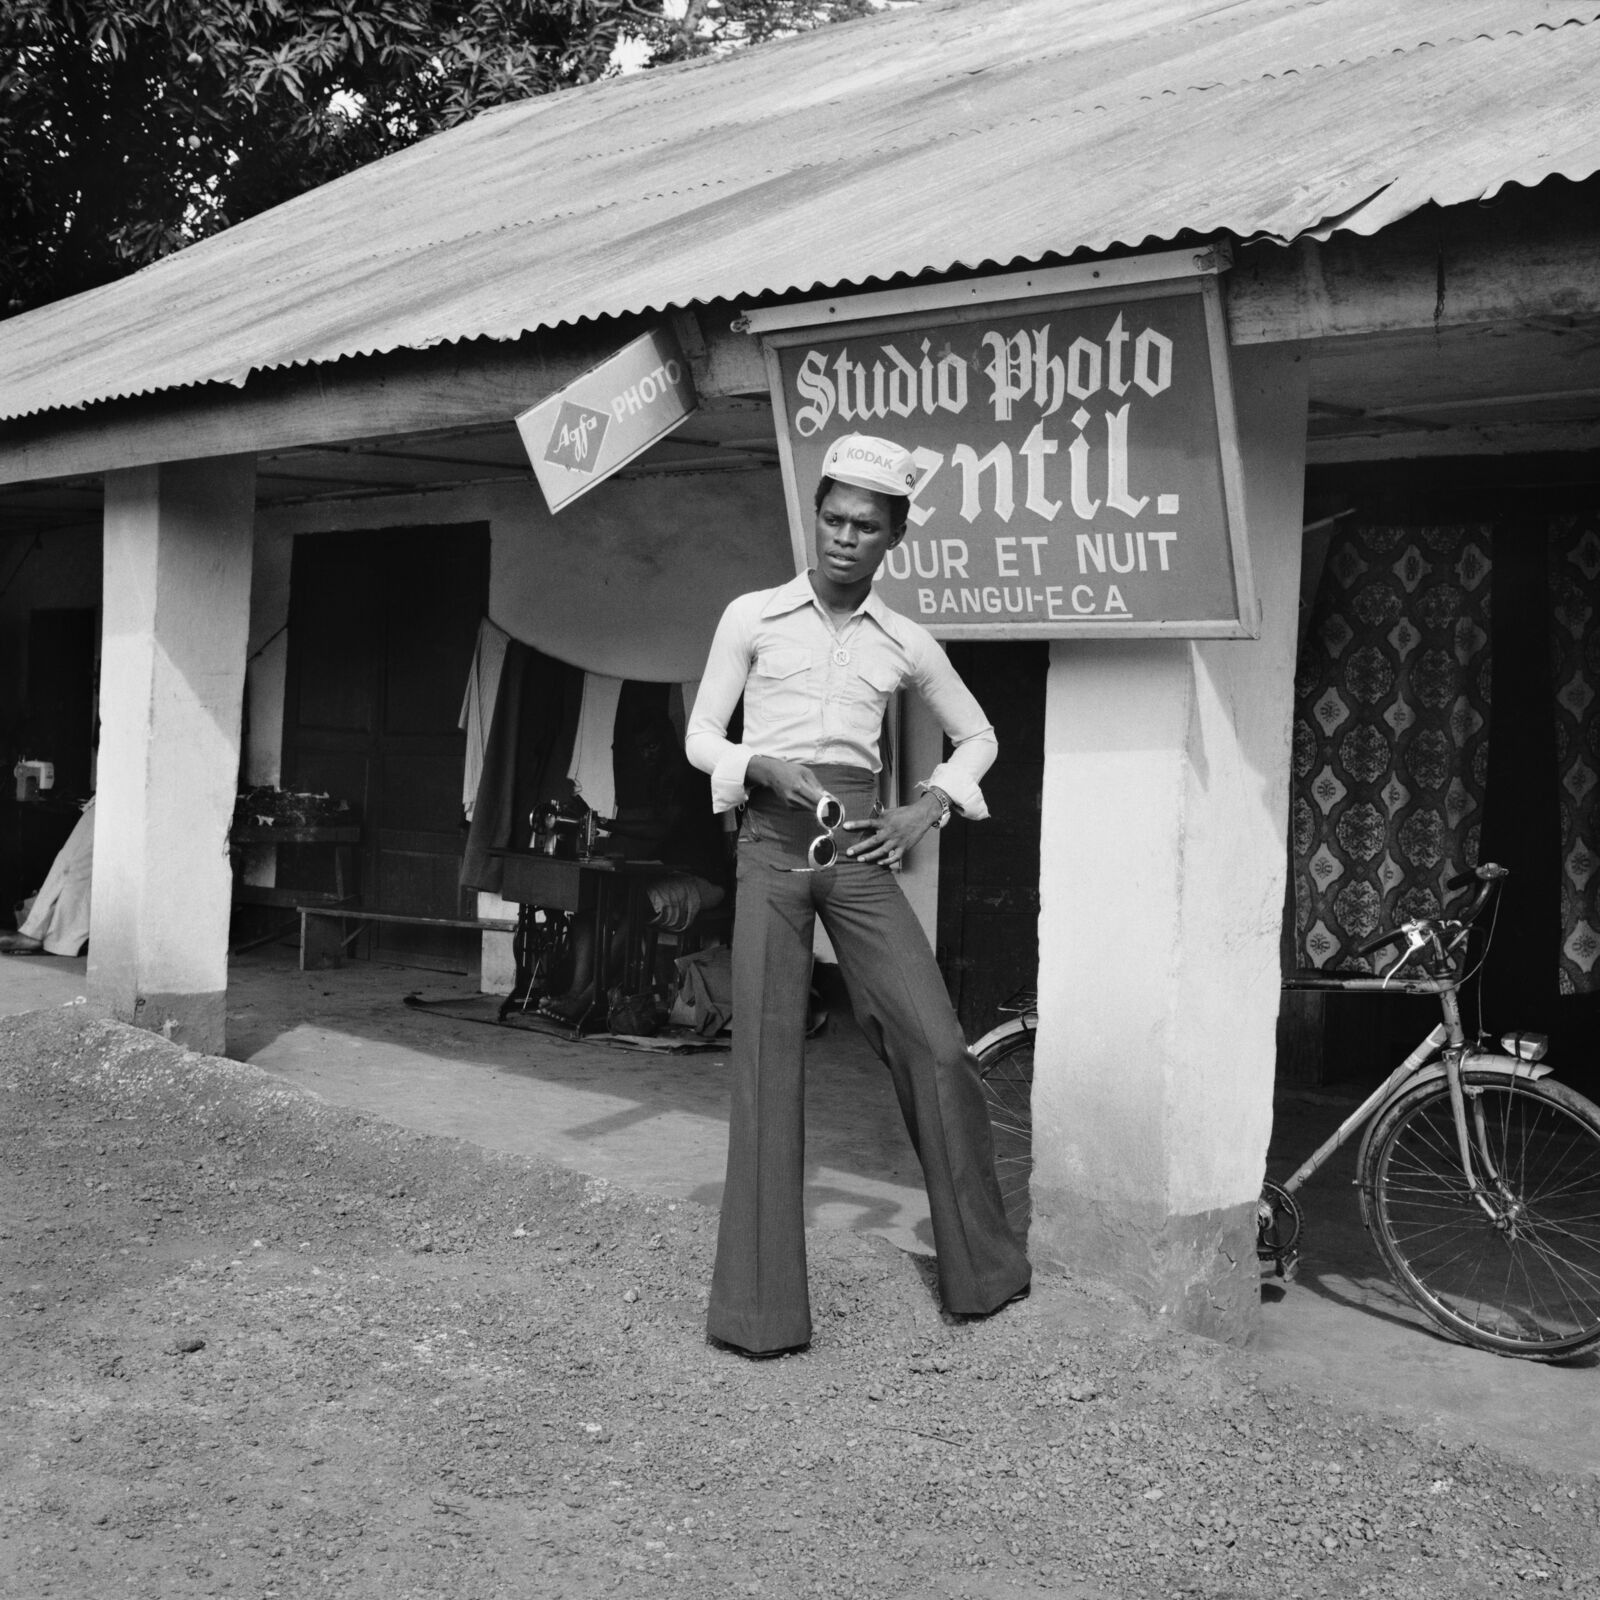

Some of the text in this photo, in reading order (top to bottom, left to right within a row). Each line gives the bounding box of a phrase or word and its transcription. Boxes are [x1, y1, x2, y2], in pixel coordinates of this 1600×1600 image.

[611, 360, 681, 424] PHOTO
[795, 310, 1174, 437] Studio Photo
[553, 414, 598, 462] Agfa
[847, 447, 893, 470] KODAK
[852, 402, 1180, 527] entil.
[995, 536, 1049, 578] ET
[1076, 531, 1178, 575] NUIT
